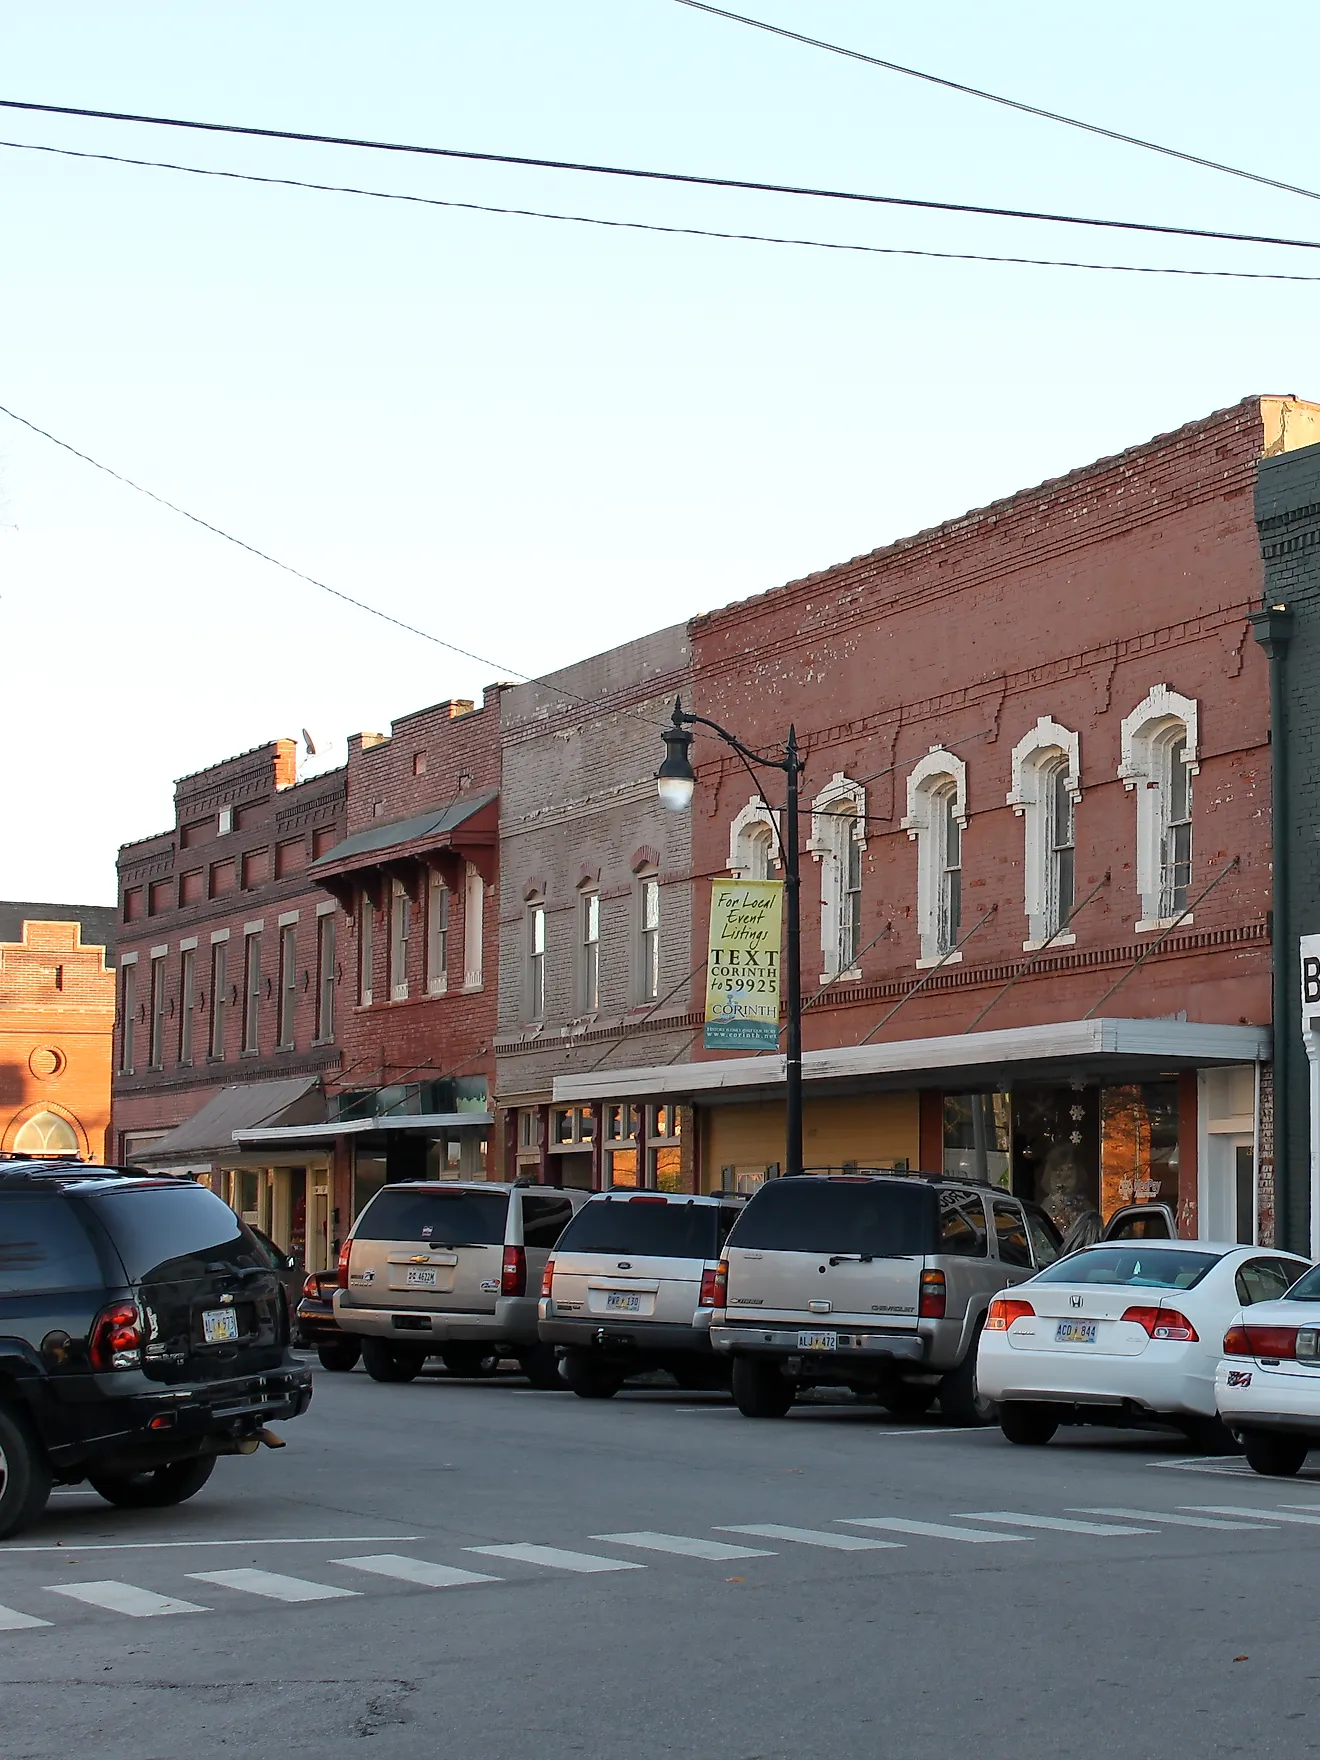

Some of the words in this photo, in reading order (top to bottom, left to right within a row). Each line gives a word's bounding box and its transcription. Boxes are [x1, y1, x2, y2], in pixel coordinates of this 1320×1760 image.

[717, 891, 740, 908] For
[742, 891, 776, 909] Local
[726, 908, 766, 924] Event
[720, 923, 769, 950] Listings
[710, 948, 779, 967] TEXT
[711, 966, 777, 978] CORINTH
[710, 977, 723, 991] to
[724, 978, 777, 993] 59925
[712, 1004, 777, 1019] CORINTH
[1080, 1325, 1096, 1337] 844
[799, 1336, 813, 1347] ALJ
[821, 1337, 835, 1348] 472
